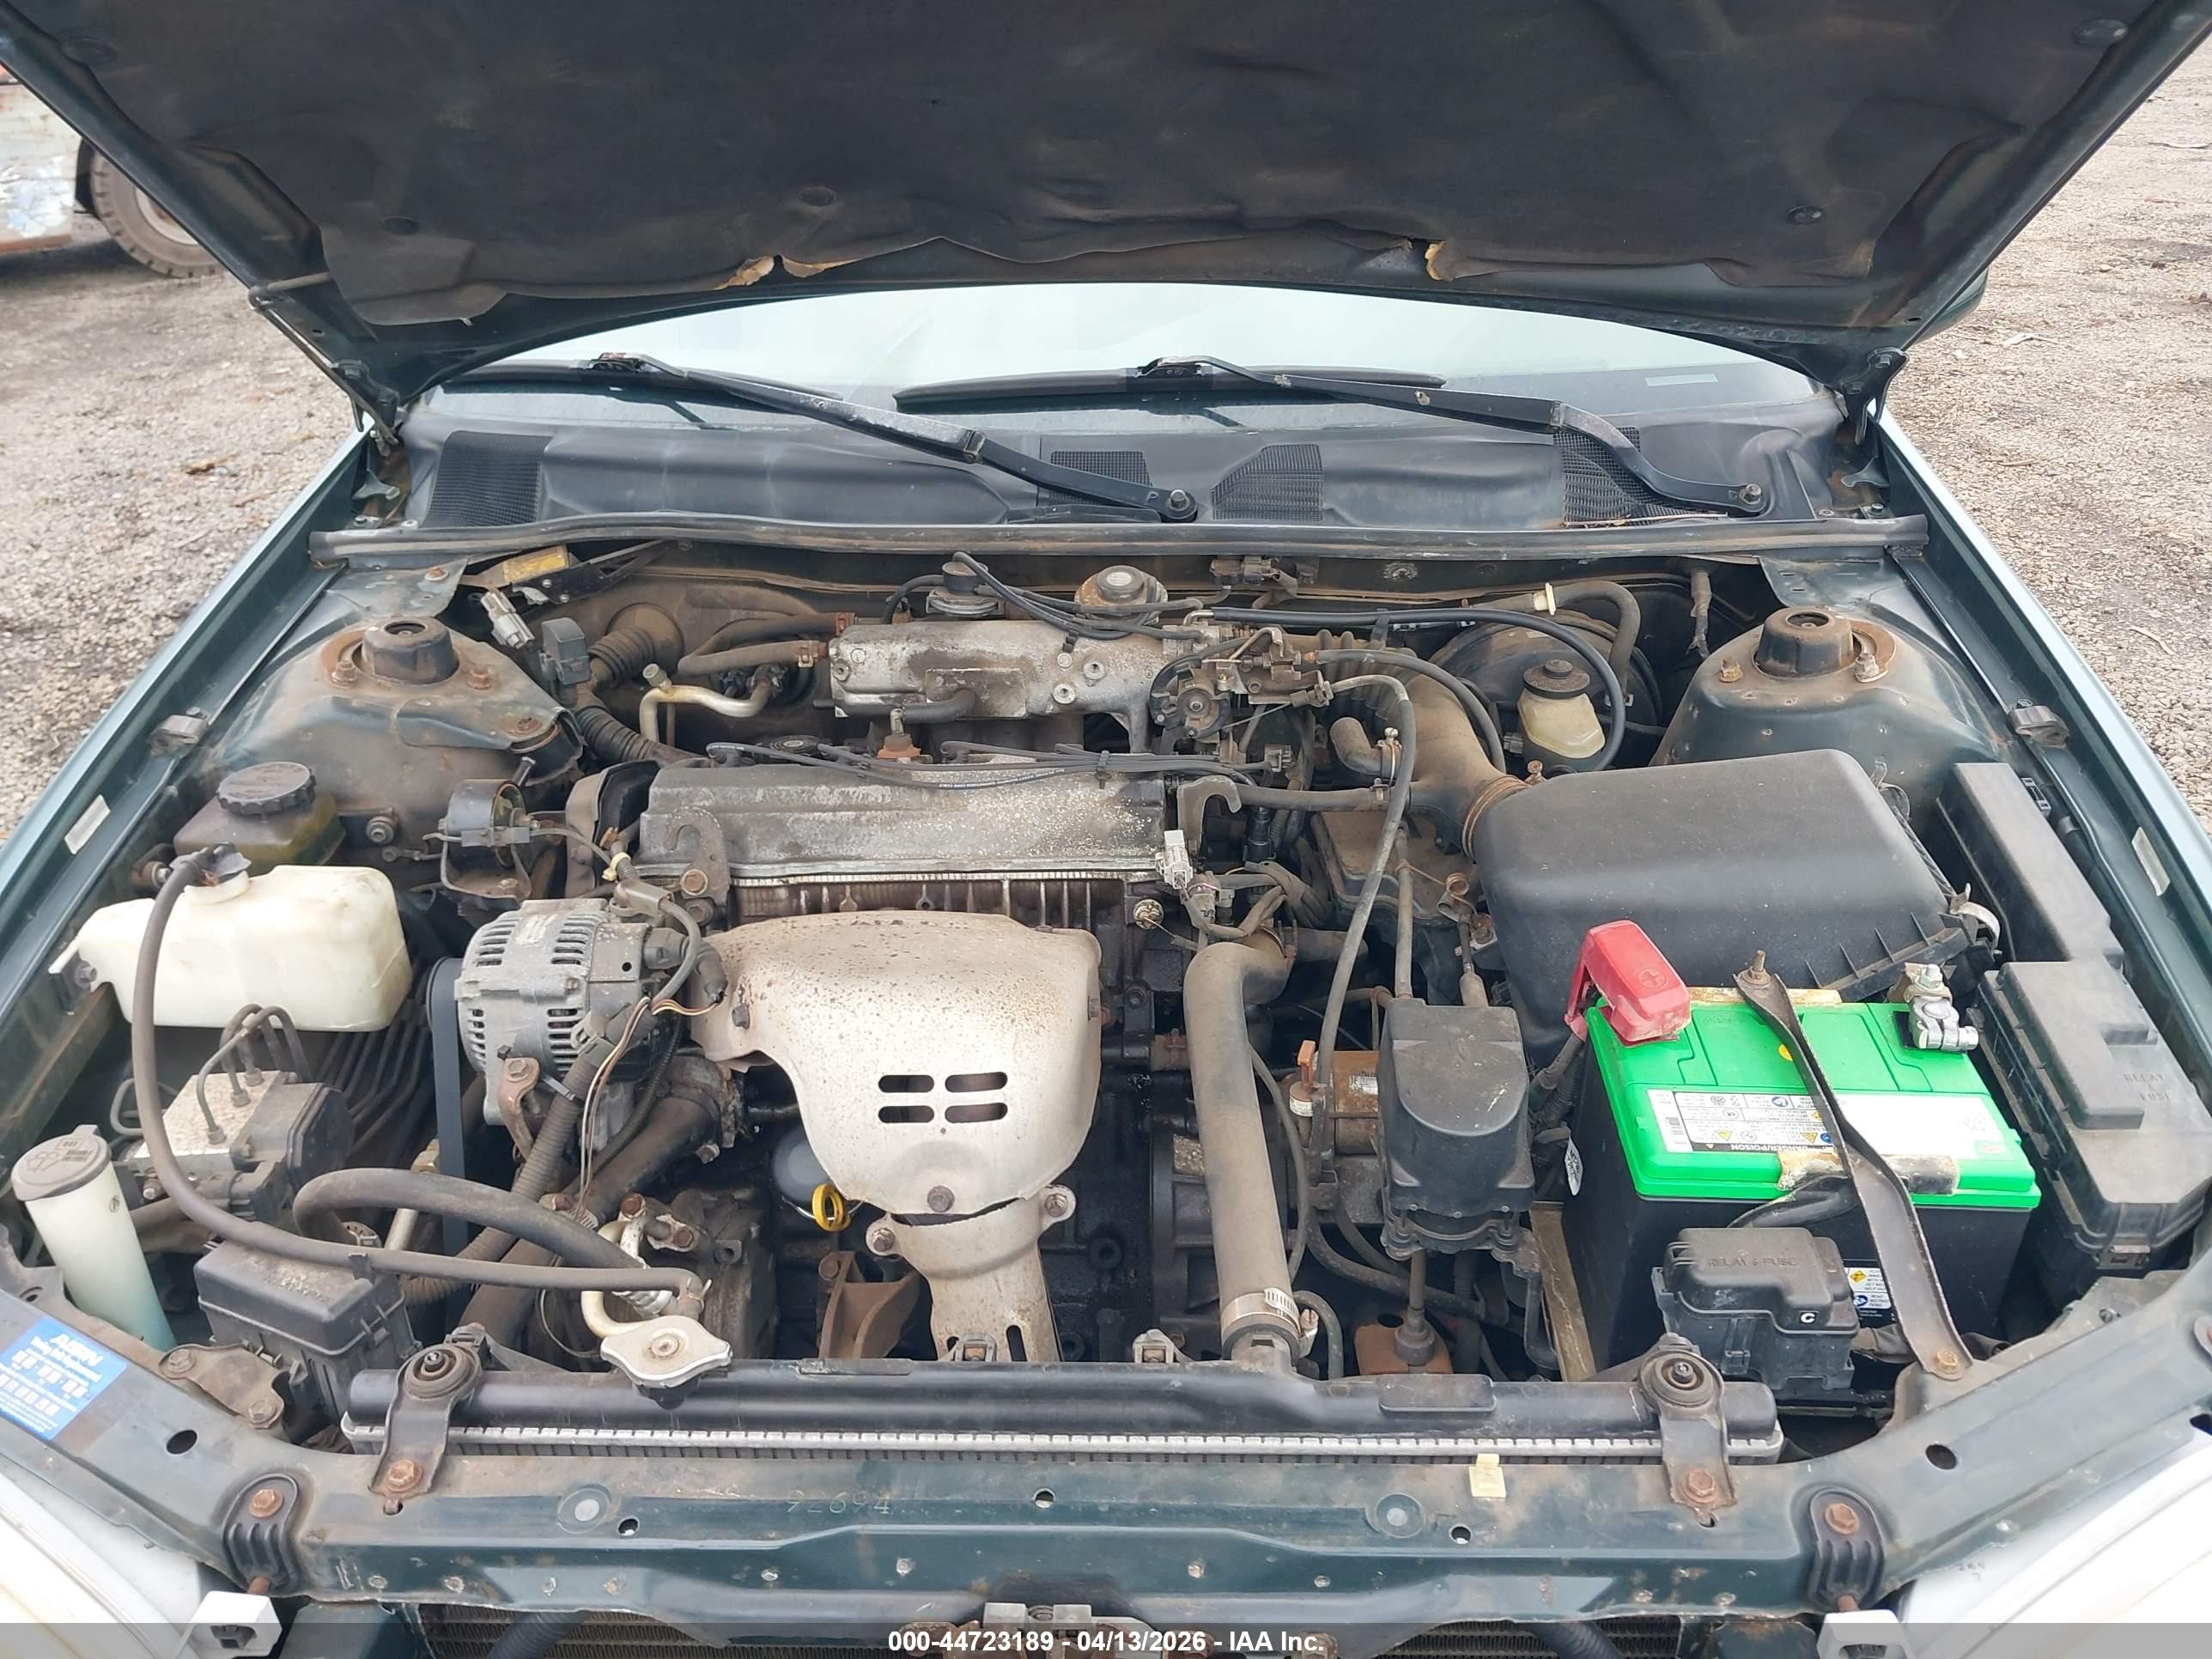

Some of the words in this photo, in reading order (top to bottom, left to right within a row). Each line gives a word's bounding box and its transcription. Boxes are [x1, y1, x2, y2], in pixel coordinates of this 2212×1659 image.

[1708, 1257, 1747, 1267] RELAY
[1763, 1257, 1798, 1267] FUSE
[1800, 1312, 1815, 1323] C
